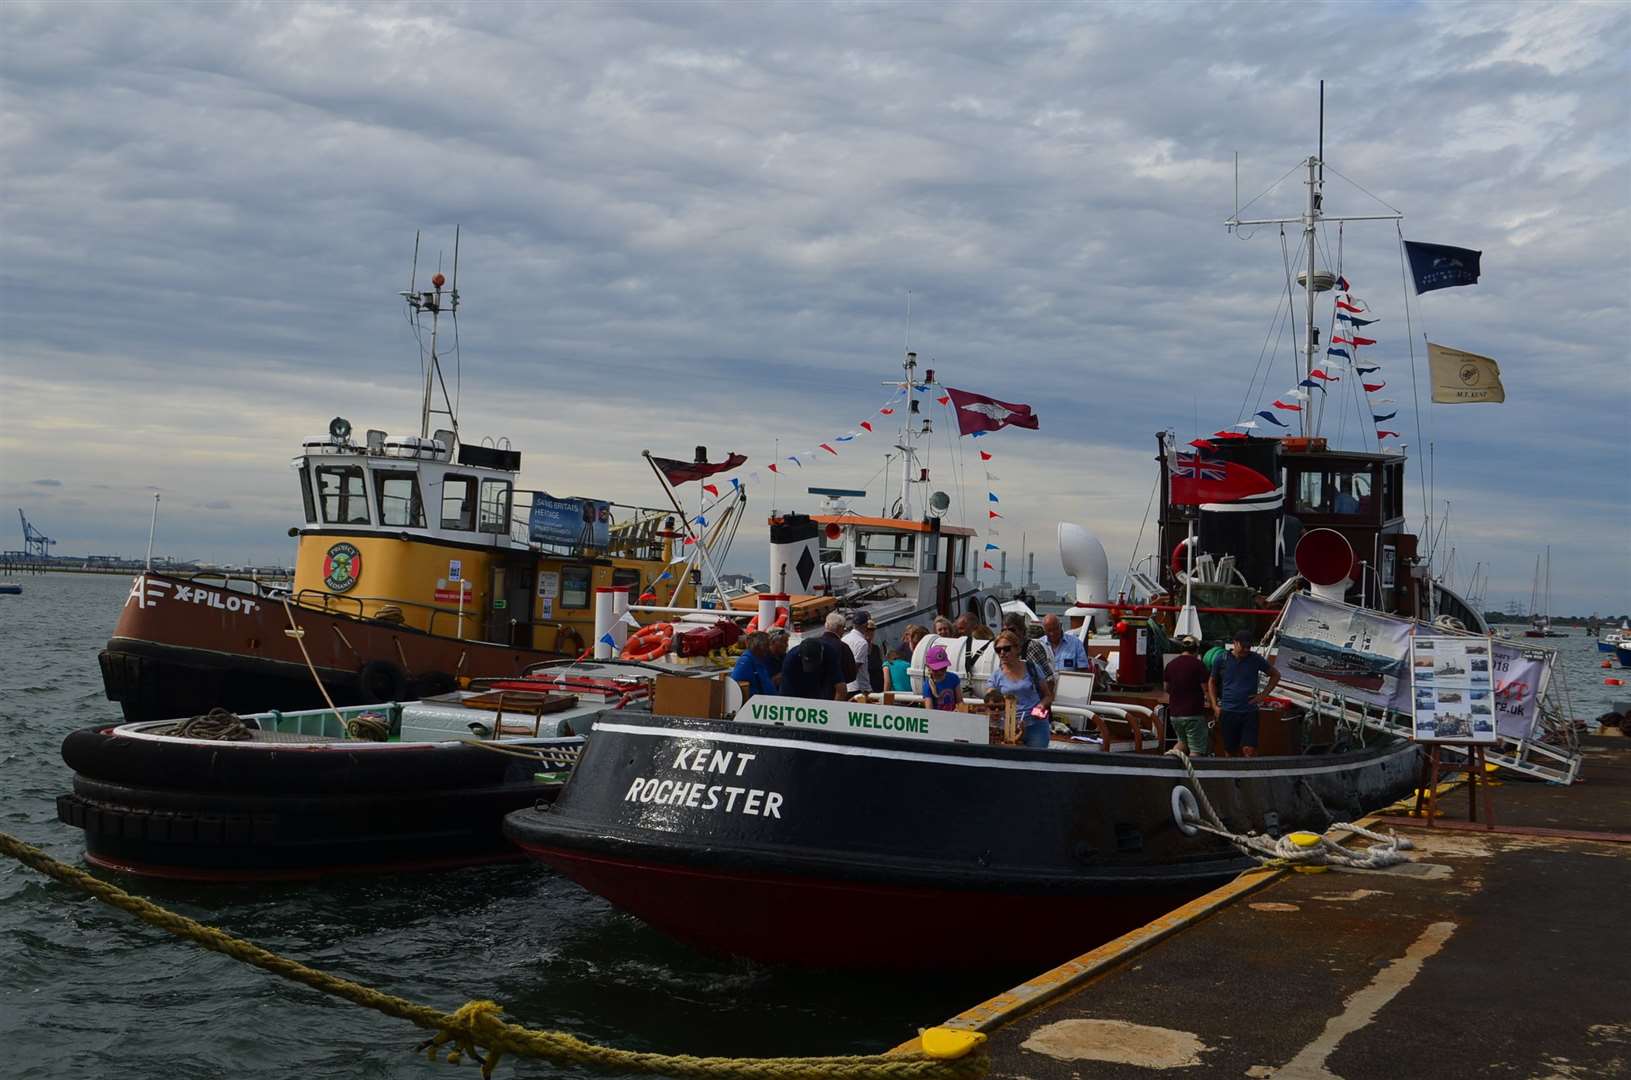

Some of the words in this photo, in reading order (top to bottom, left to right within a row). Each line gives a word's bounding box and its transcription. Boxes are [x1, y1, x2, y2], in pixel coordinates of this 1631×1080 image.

[174, 584, 256, 615] X-PILOT
[751, 704, 829, 725] VISITORS
[848, 711, 929, 734] WELCOME
[672, 748, 756, 776] KENT
[624, 777, 784, 819] ROCHESTER
